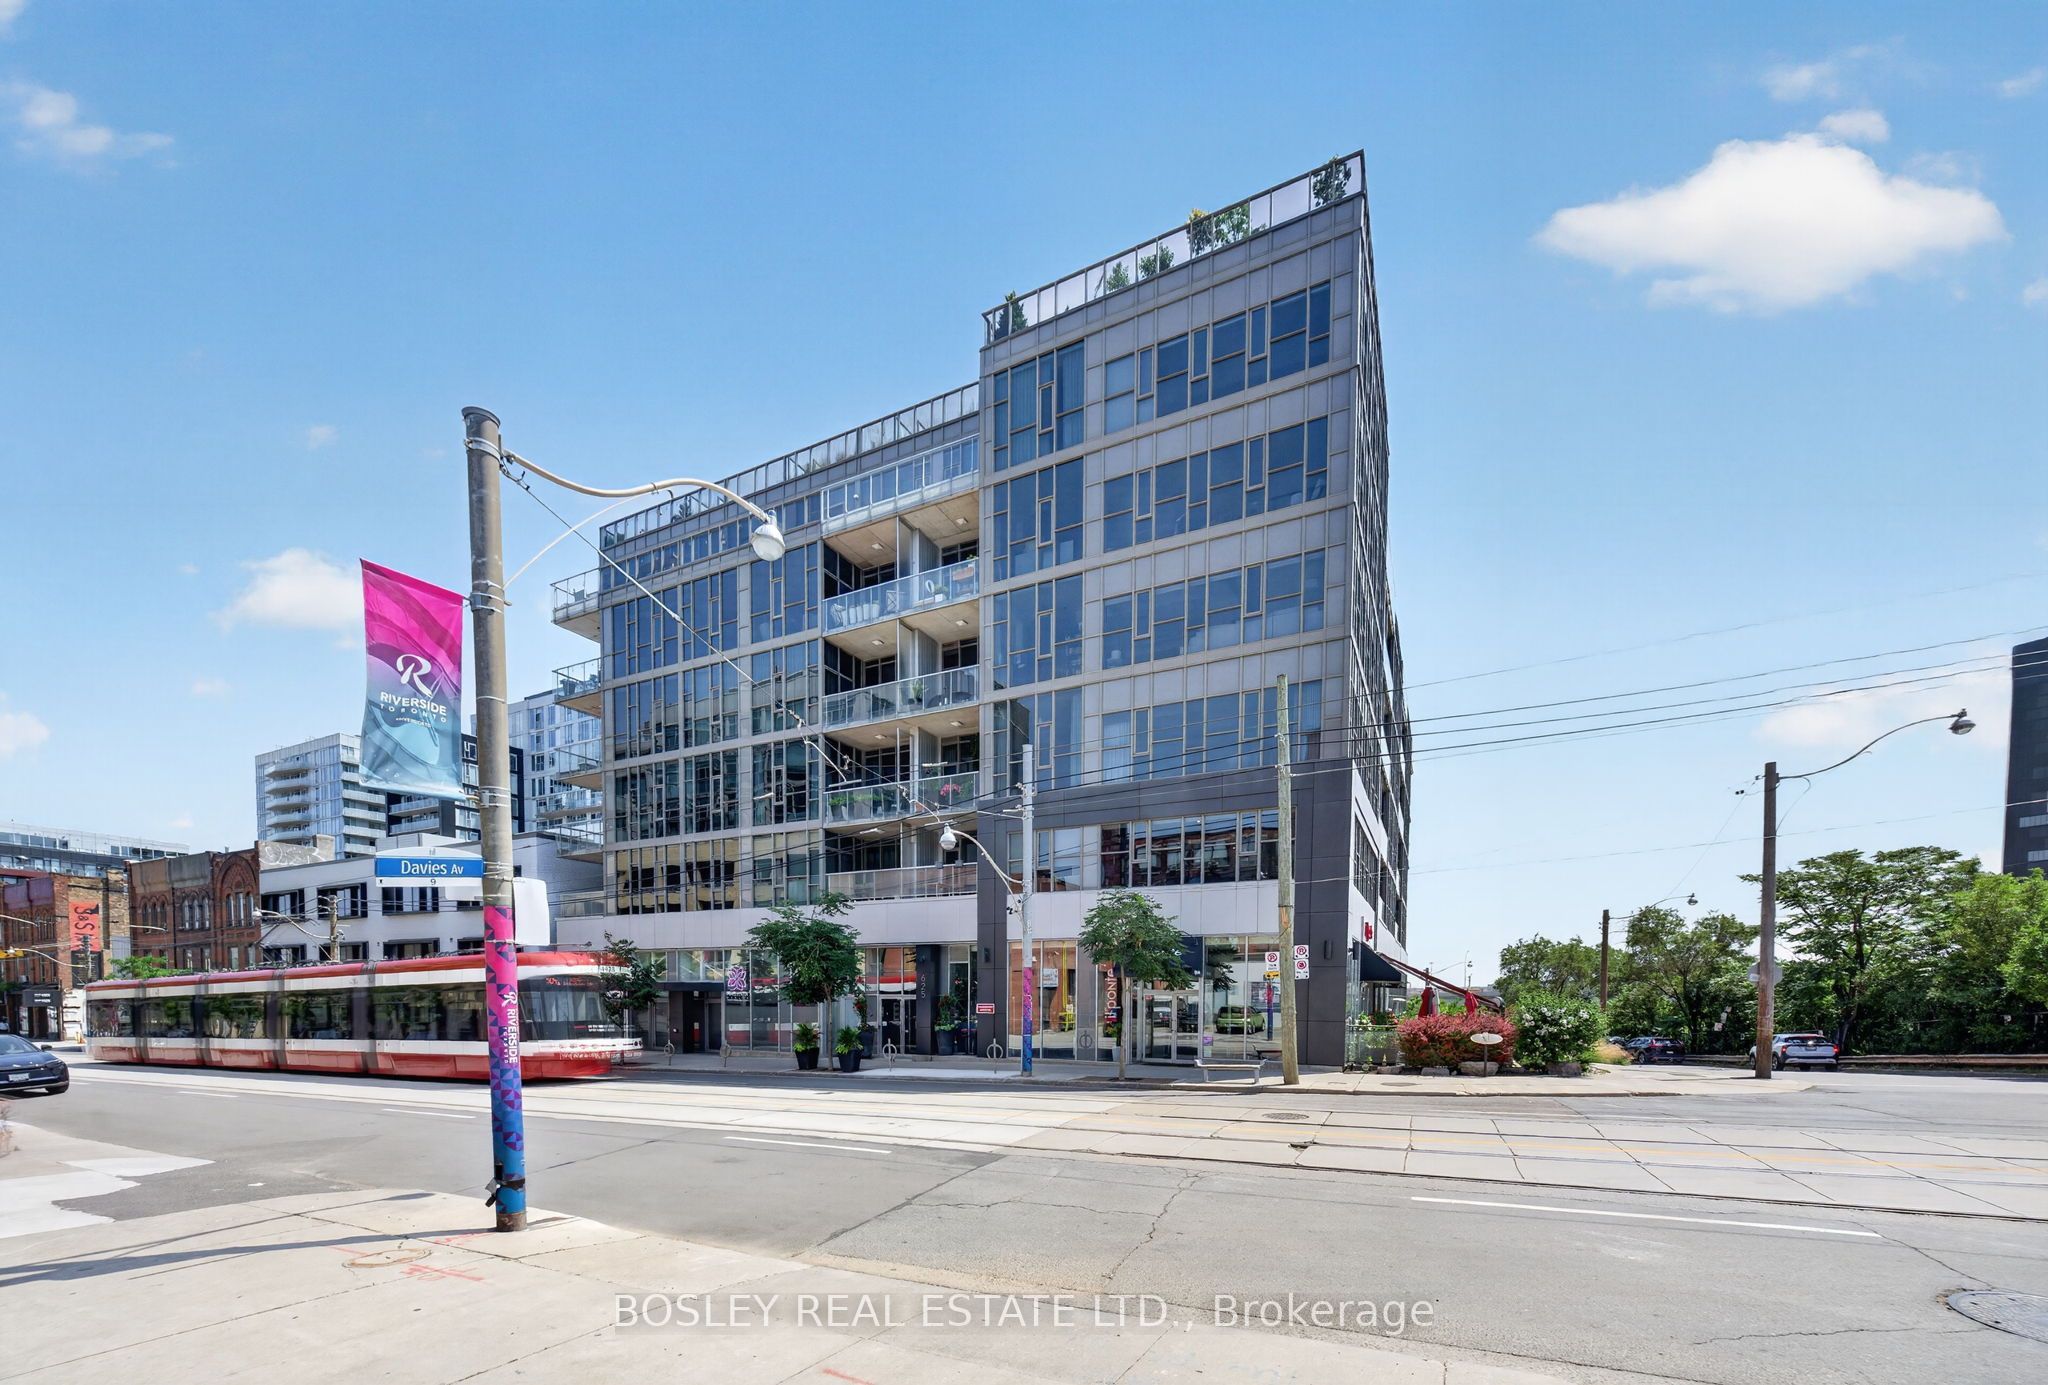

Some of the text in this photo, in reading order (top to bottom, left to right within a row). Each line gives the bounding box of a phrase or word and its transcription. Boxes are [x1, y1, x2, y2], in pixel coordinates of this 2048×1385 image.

[380, 691, 447, 716] RIVERSIDE
[401, 860, 464, 874] Davies Av
[507, 1008, 518, 1063] RIVERSIDE
